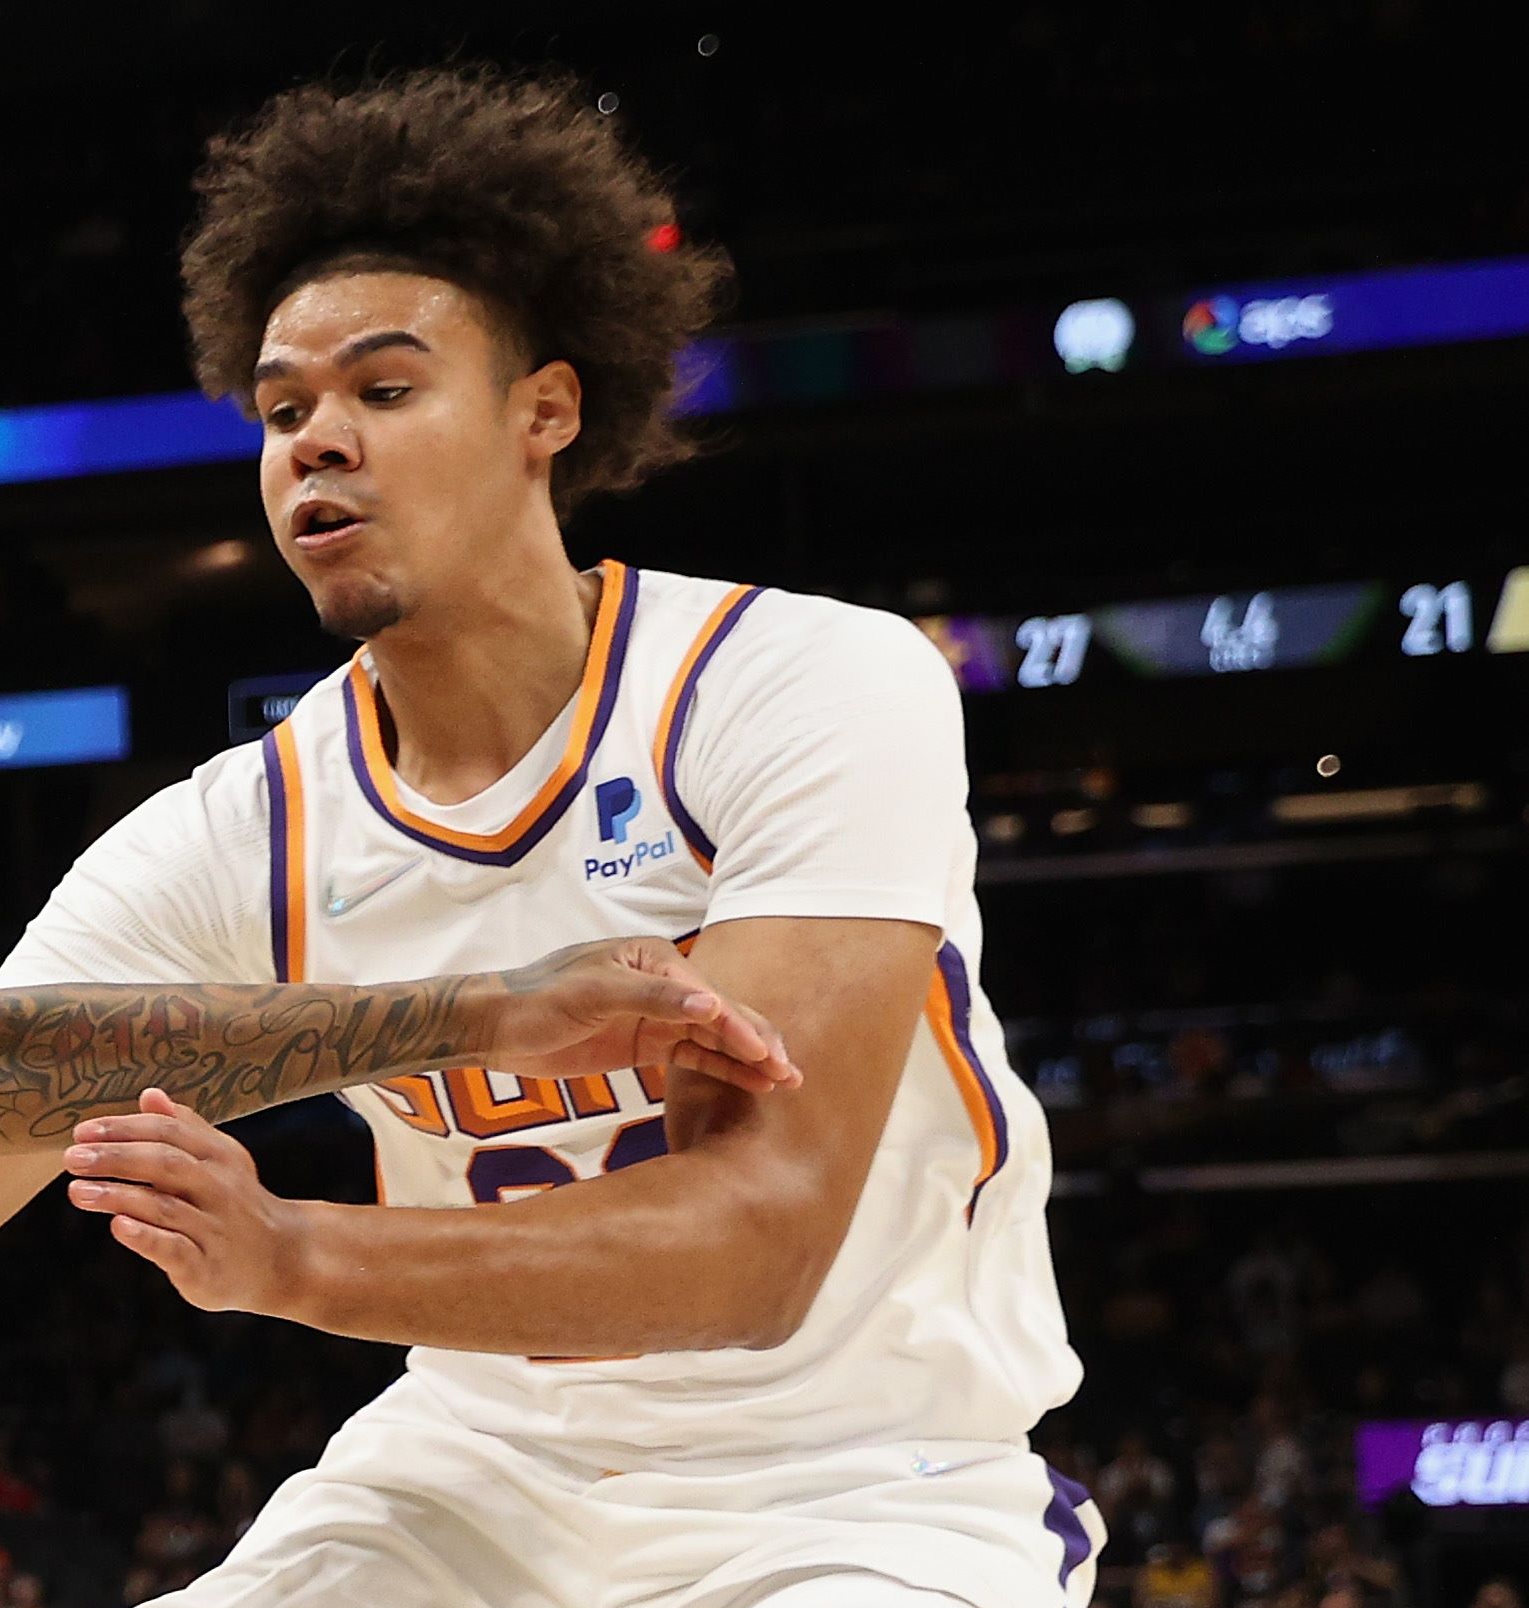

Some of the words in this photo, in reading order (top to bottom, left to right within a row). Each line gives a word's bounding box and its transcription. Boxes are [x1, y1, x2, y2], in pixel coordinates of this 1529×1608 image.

[1015, 613, 1092, 688] 27
[1399, 580, 1474, 656] 21
[584, 831, 676, 883] PayPal
